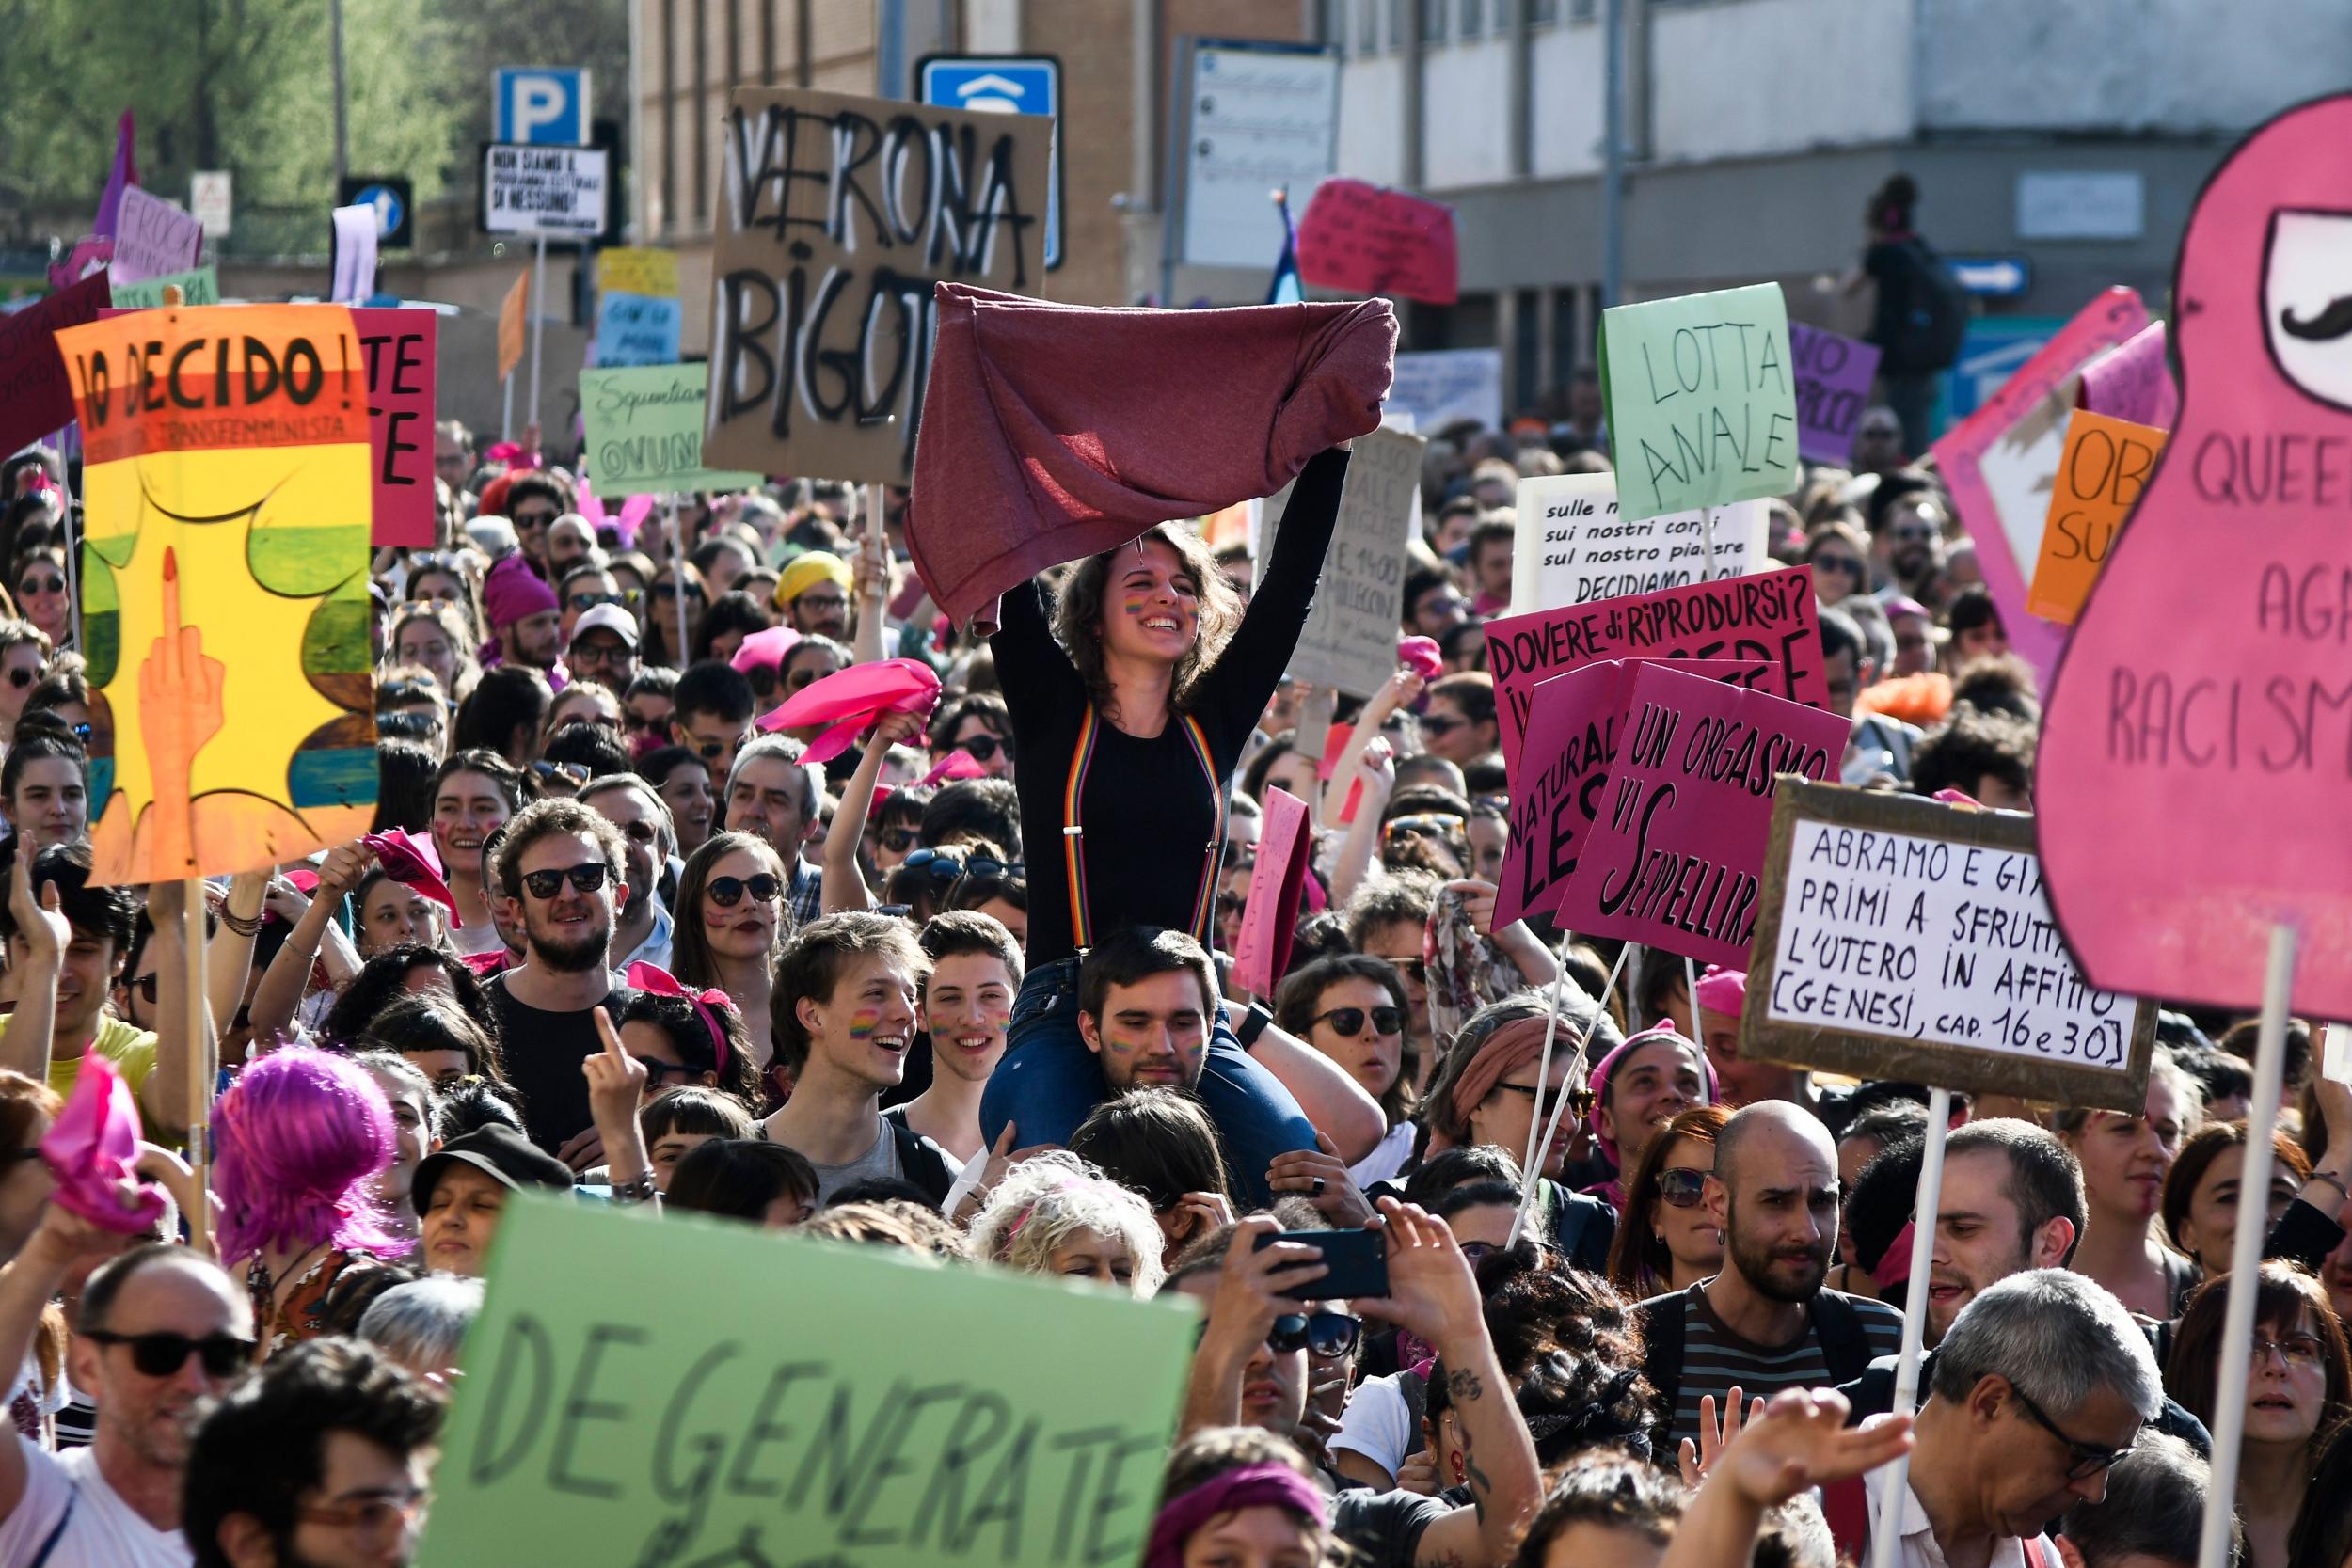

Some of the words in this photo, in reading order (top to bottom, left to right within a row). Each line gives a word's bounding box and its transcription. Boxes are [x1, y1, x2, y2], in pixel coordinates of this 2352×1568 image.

[512, 74, 567, 143] P
[724, 103, 1035, 289] VERONA
[76, 349, 111, 432] IO
[1643, 322, 1787, 404] LOTTA
[366, 407, 419, 485] E
[1640, 403, 1792, 510] ANALE
[2071, 429, 2163, 506] OB
[2192, 430, 2352, 508] QUEE
[1544, 525, 1577, 542] sui
[1586, 521, 1655, 540] nostri
[1547, 499, 1595, 518] sulle
[1543, 548, 1576, 566] sul
[1585, 546, 1660, 563] nostro
[1669, 542, 1744, 562] piaere
[1488, 614, 1608, 684] DOVERE
[1605, 609, 1623, 641] di
[1509, 710, 1629, 861] NATURAL
[1631, 701, 1681, 769] UN
[1683, 716, 1829, 799] ORGASMO
[1612, 776, 1645, 835] VI
[1810, 828, 1948, 882] ABRAMO
[1963, 847, 1982, 887] E
[1996, 854, 2043, 897] GI
[1788, 927, 1917, 983] L'UTERO
[1905, 890, 1929, 935] A
[1951, 900, 2065, 958] SFRUTT
[468, 1313, 1171, 1563] DEGENERATE
